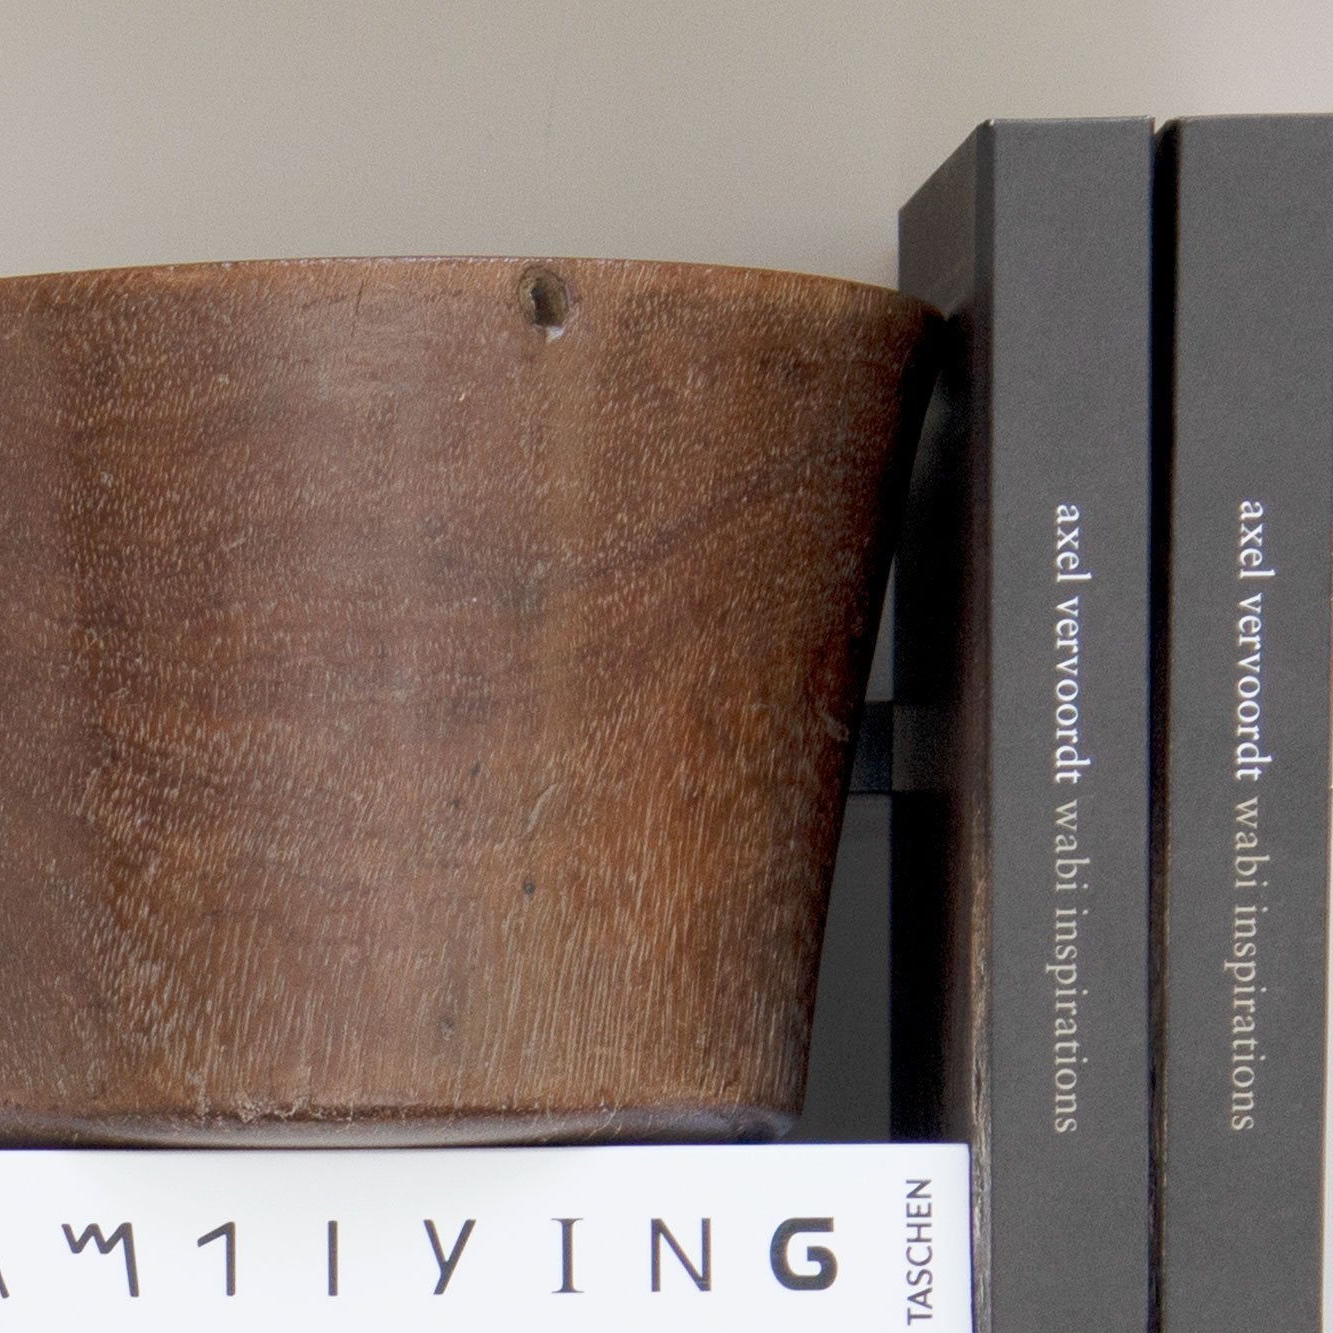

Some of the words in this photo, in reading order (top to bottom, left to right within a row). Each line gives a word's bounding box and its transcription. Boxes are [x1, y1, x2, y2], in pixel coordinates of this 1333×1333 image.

[1054, 503, 1093, 584] axel
[1236, 499, 1277, 581] axel
[1053, 594, 1092, 786] vervoordt
[1234, 591, 1274, 783] vervoordt
[1053, 797, 1091, 893] wabi
[1232, 794, 1271, 890] wabi
[1044, 906, 1089, 1135] inspirations
[1223, 903, 1269, 1132] inspirations
[904, 1178, 934, 1327] TASCHEN
